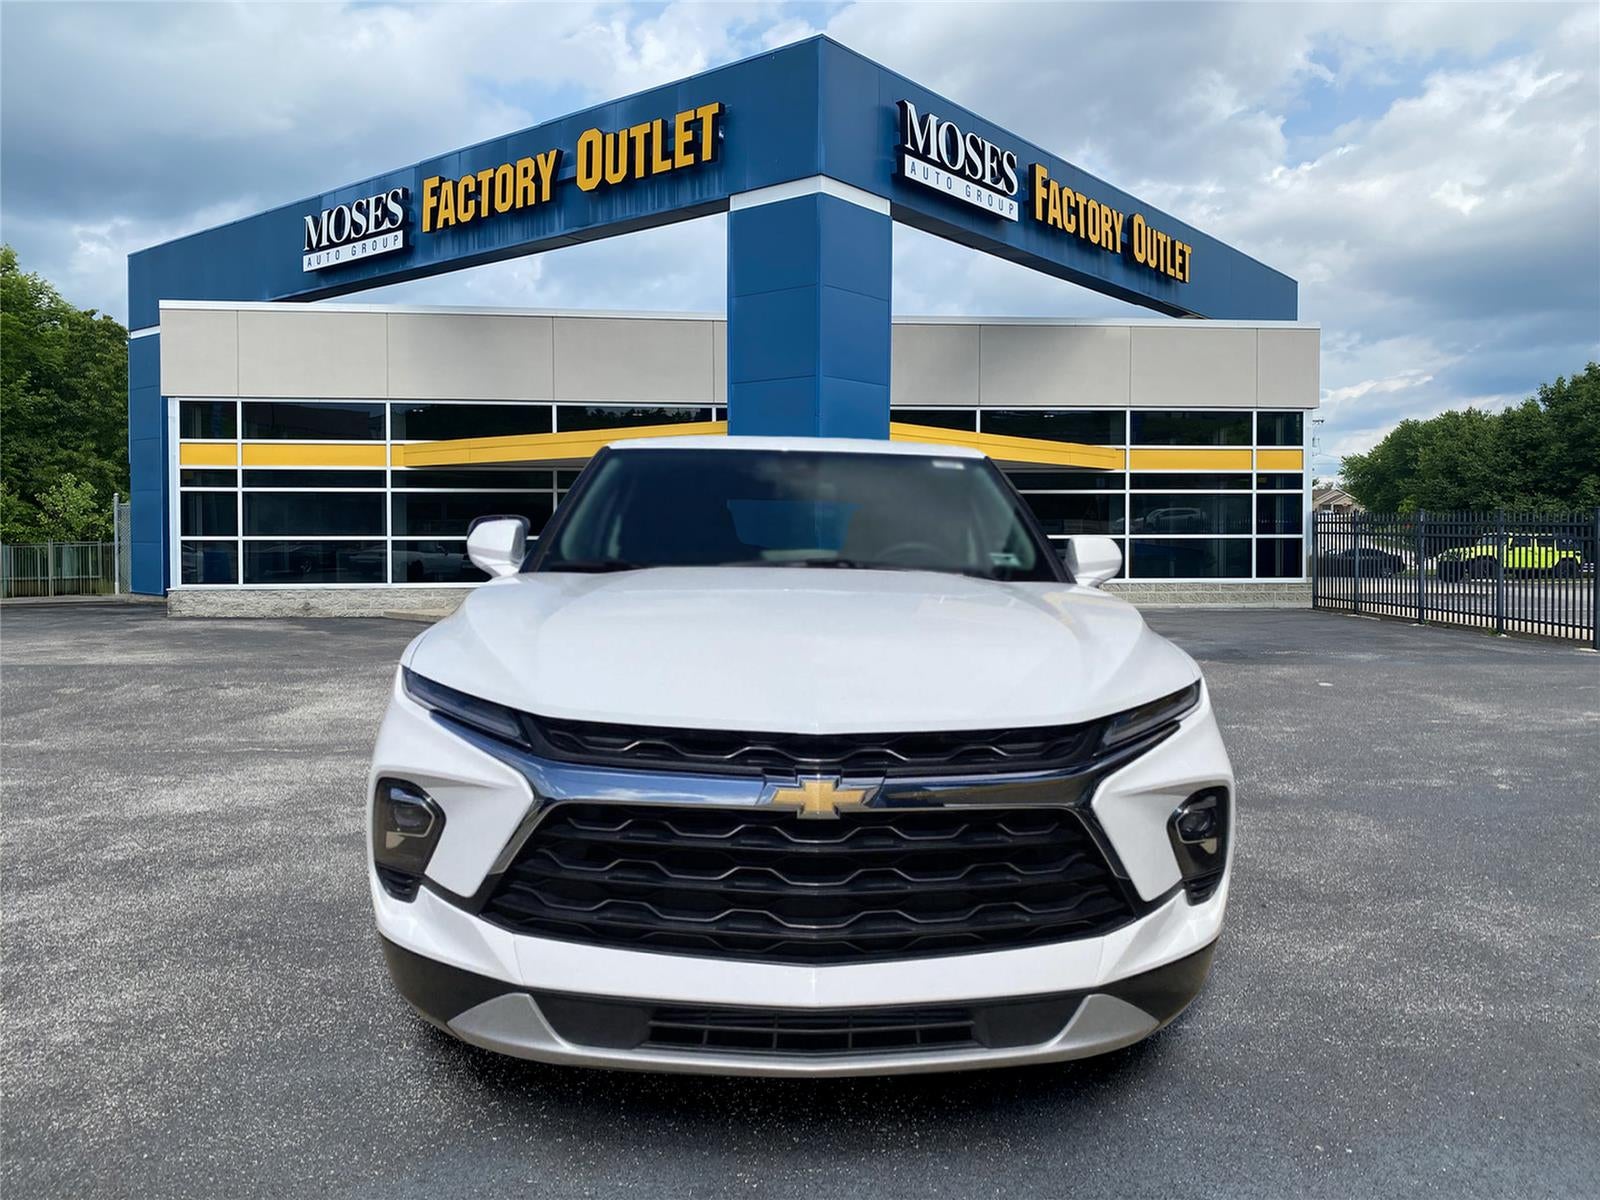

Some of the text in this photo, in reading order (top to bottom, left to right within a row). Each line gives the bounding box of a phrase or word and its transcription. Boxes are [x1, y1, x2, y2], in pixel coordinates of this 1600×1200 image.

[904, 101, 1018, 196] MOSES
[910, 161, 1014, 215] AUTO GROUP
[303, 188, 403, 251] MOSES
[307, 235, 400, 267] AUTO GROUP
